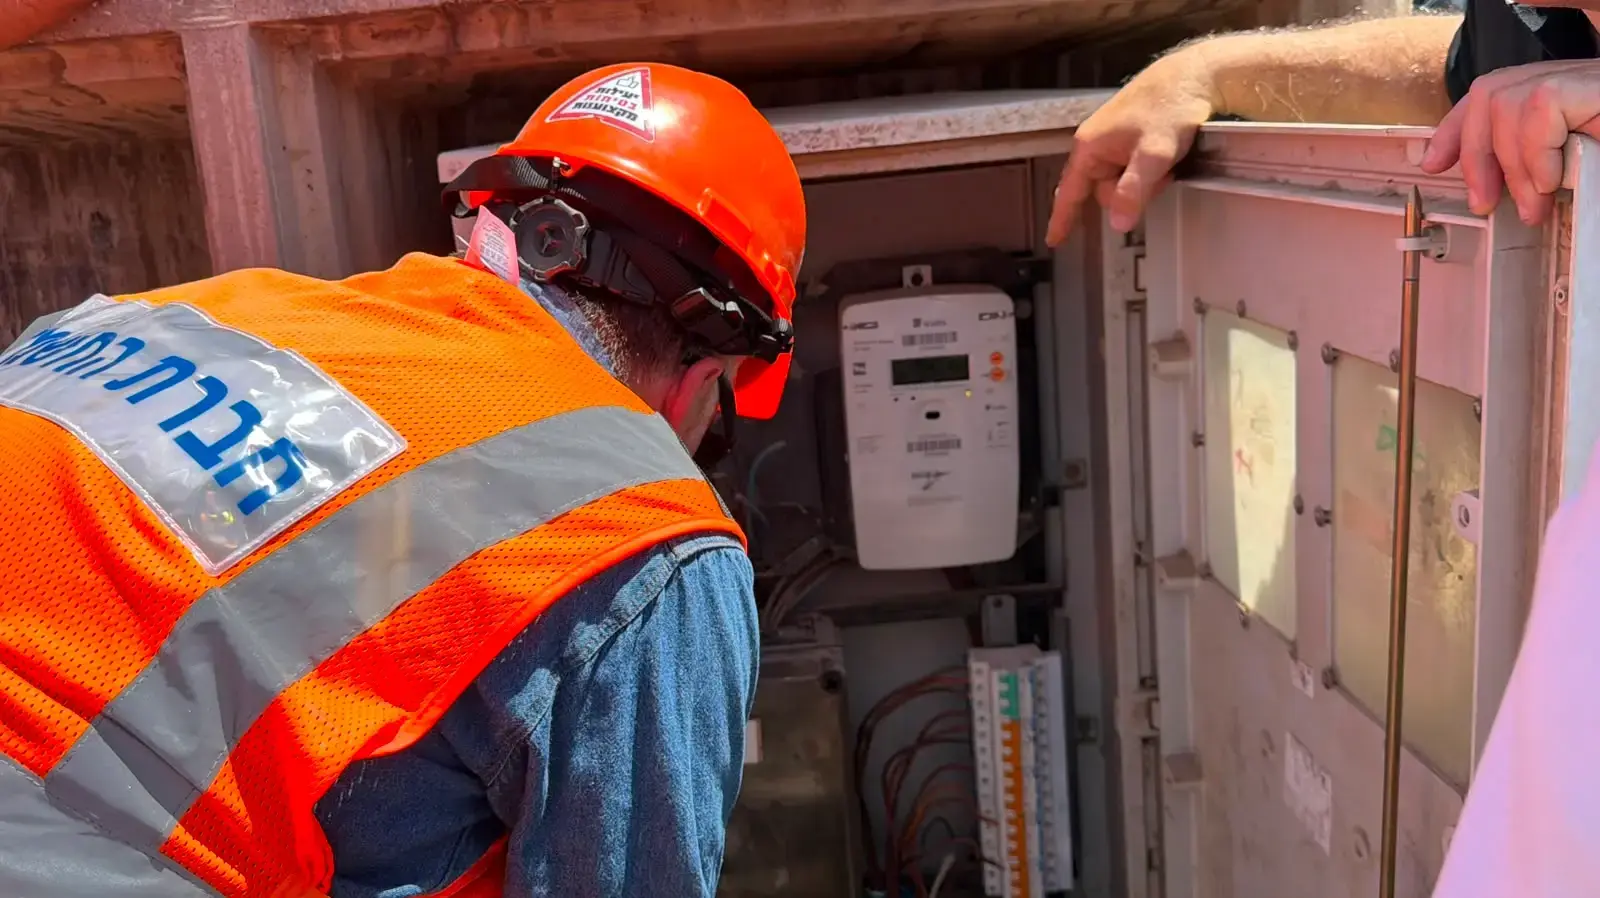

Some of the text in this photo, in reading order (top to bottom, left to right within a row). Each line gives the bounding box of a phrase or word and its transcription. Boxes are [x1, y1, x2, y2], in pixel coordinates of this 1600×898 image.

[595, 88, 639, 99] יעילות
[585, 95, 637, 109] בטיחות
[573, 102, 638, 121] מקצוענות
[104, 355, 305, 515] חברת
